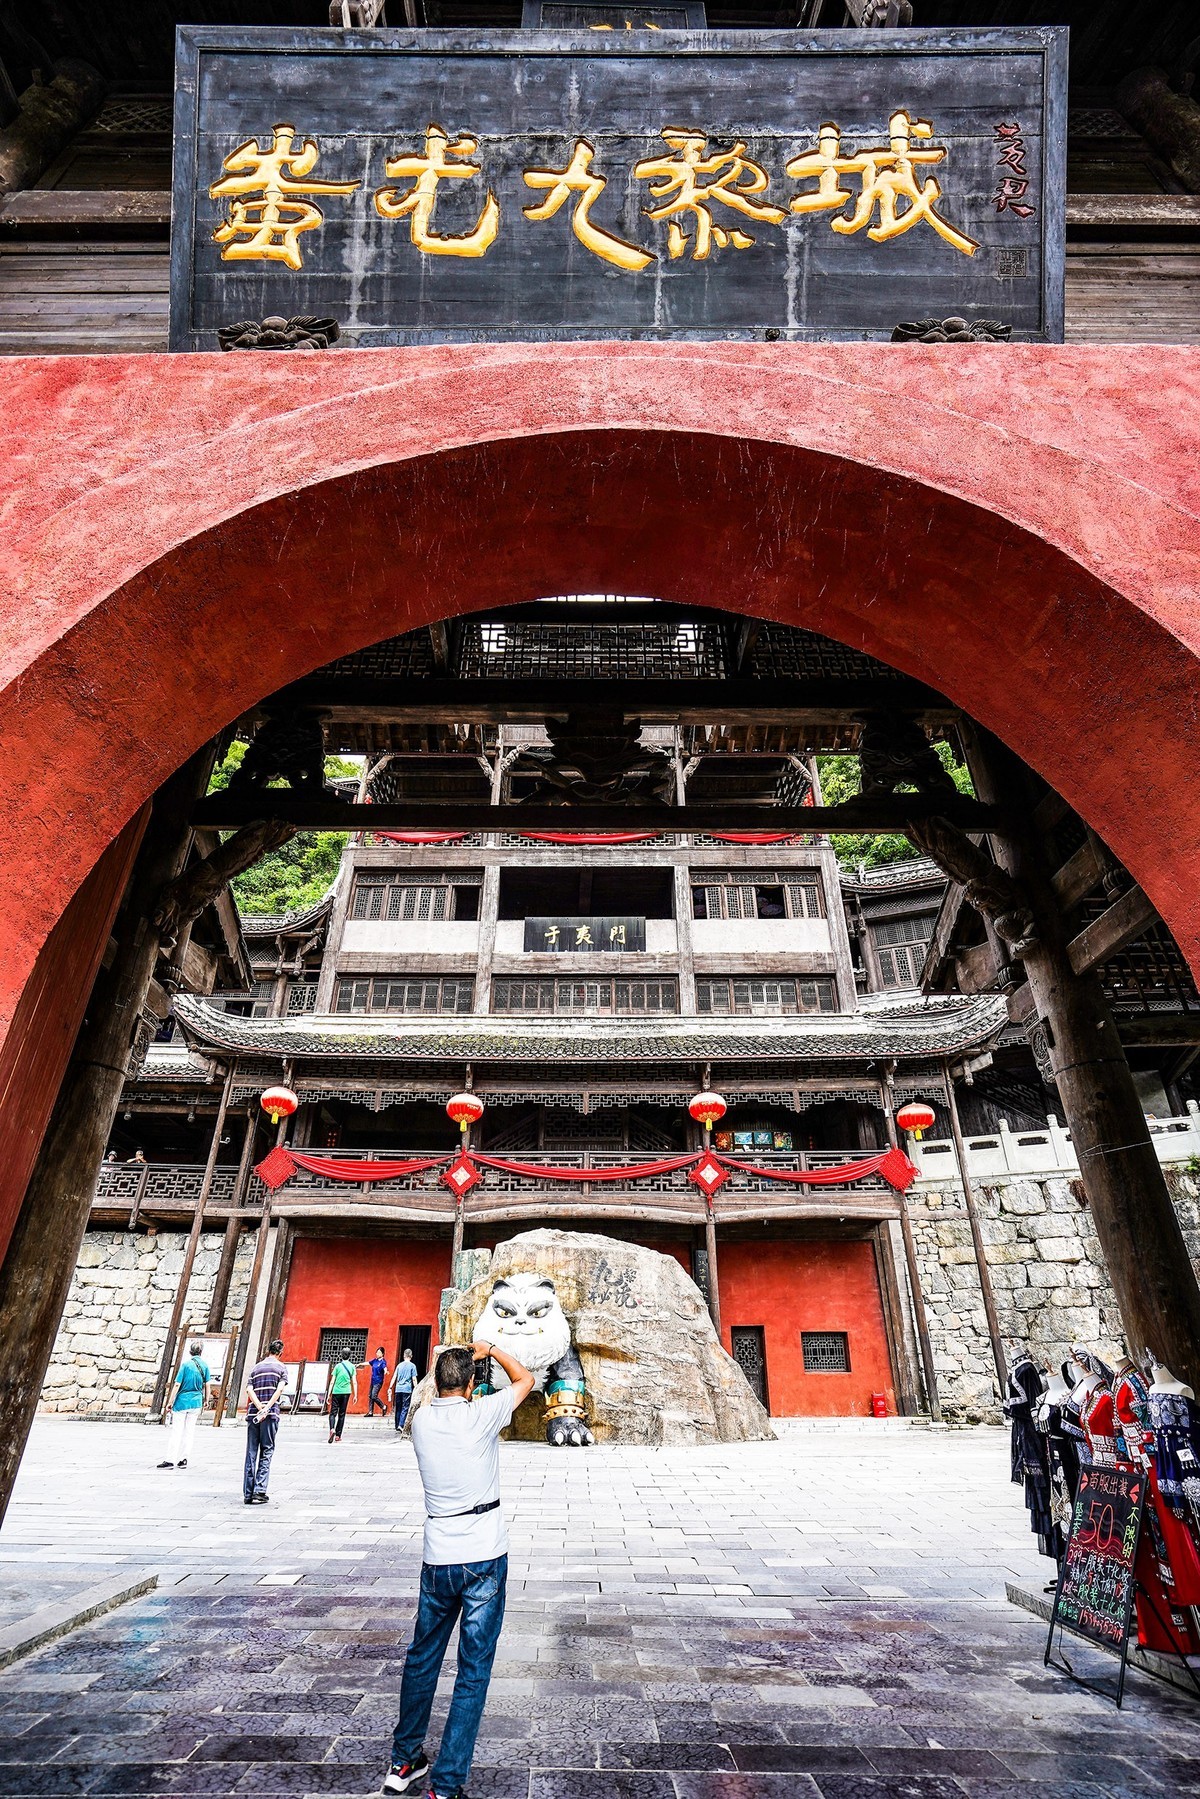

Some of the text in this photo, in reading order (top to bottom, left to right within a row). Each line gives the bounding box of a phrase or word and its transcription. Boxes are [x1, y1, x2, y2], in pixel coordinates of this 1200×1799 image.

[209, 110, 981, 271] 蚩尤九黎城
[1080, 1499, 1114, 1549] 50
